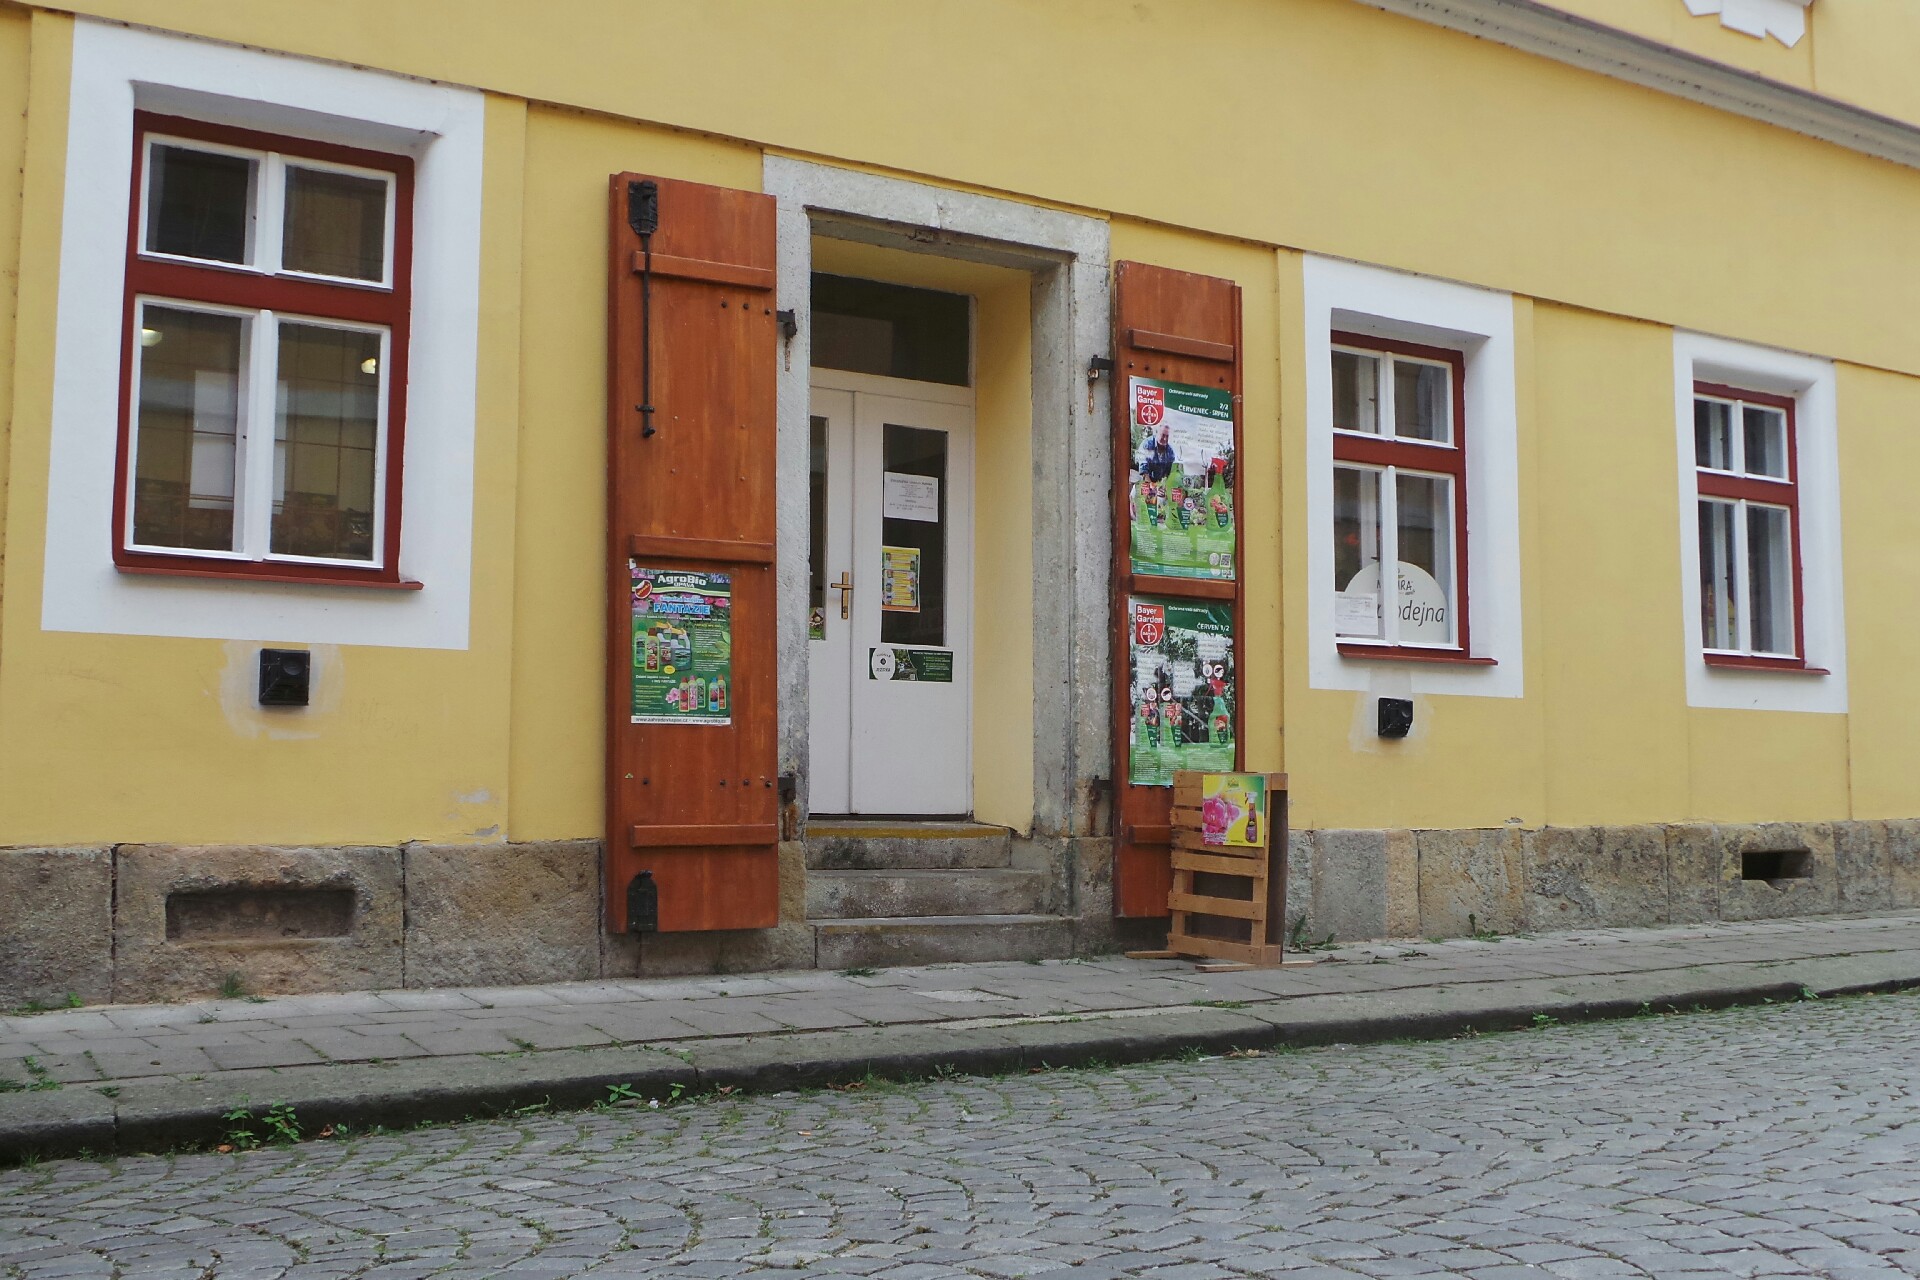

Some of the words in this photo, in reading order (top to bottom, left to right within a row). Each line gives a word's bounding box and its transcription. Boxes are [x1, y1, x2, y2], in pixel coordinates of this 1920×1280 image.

[1137, 387, 1157, 396] Bayer
[1137, 396, 1163, 405] Garden
[1178, 404, 1208, 415] ČERVENEC
[1212, 409, 1229, 419] SRPEN
[657, 574, 707, 586] AgroBio
[653, 602, 711, 615] FANTAZIE
[1137, 605, 1157, 615] Bayer
[1137, 614, 1163, 624] Garden
[1196, 622, 1219, 631] ČERVEN
